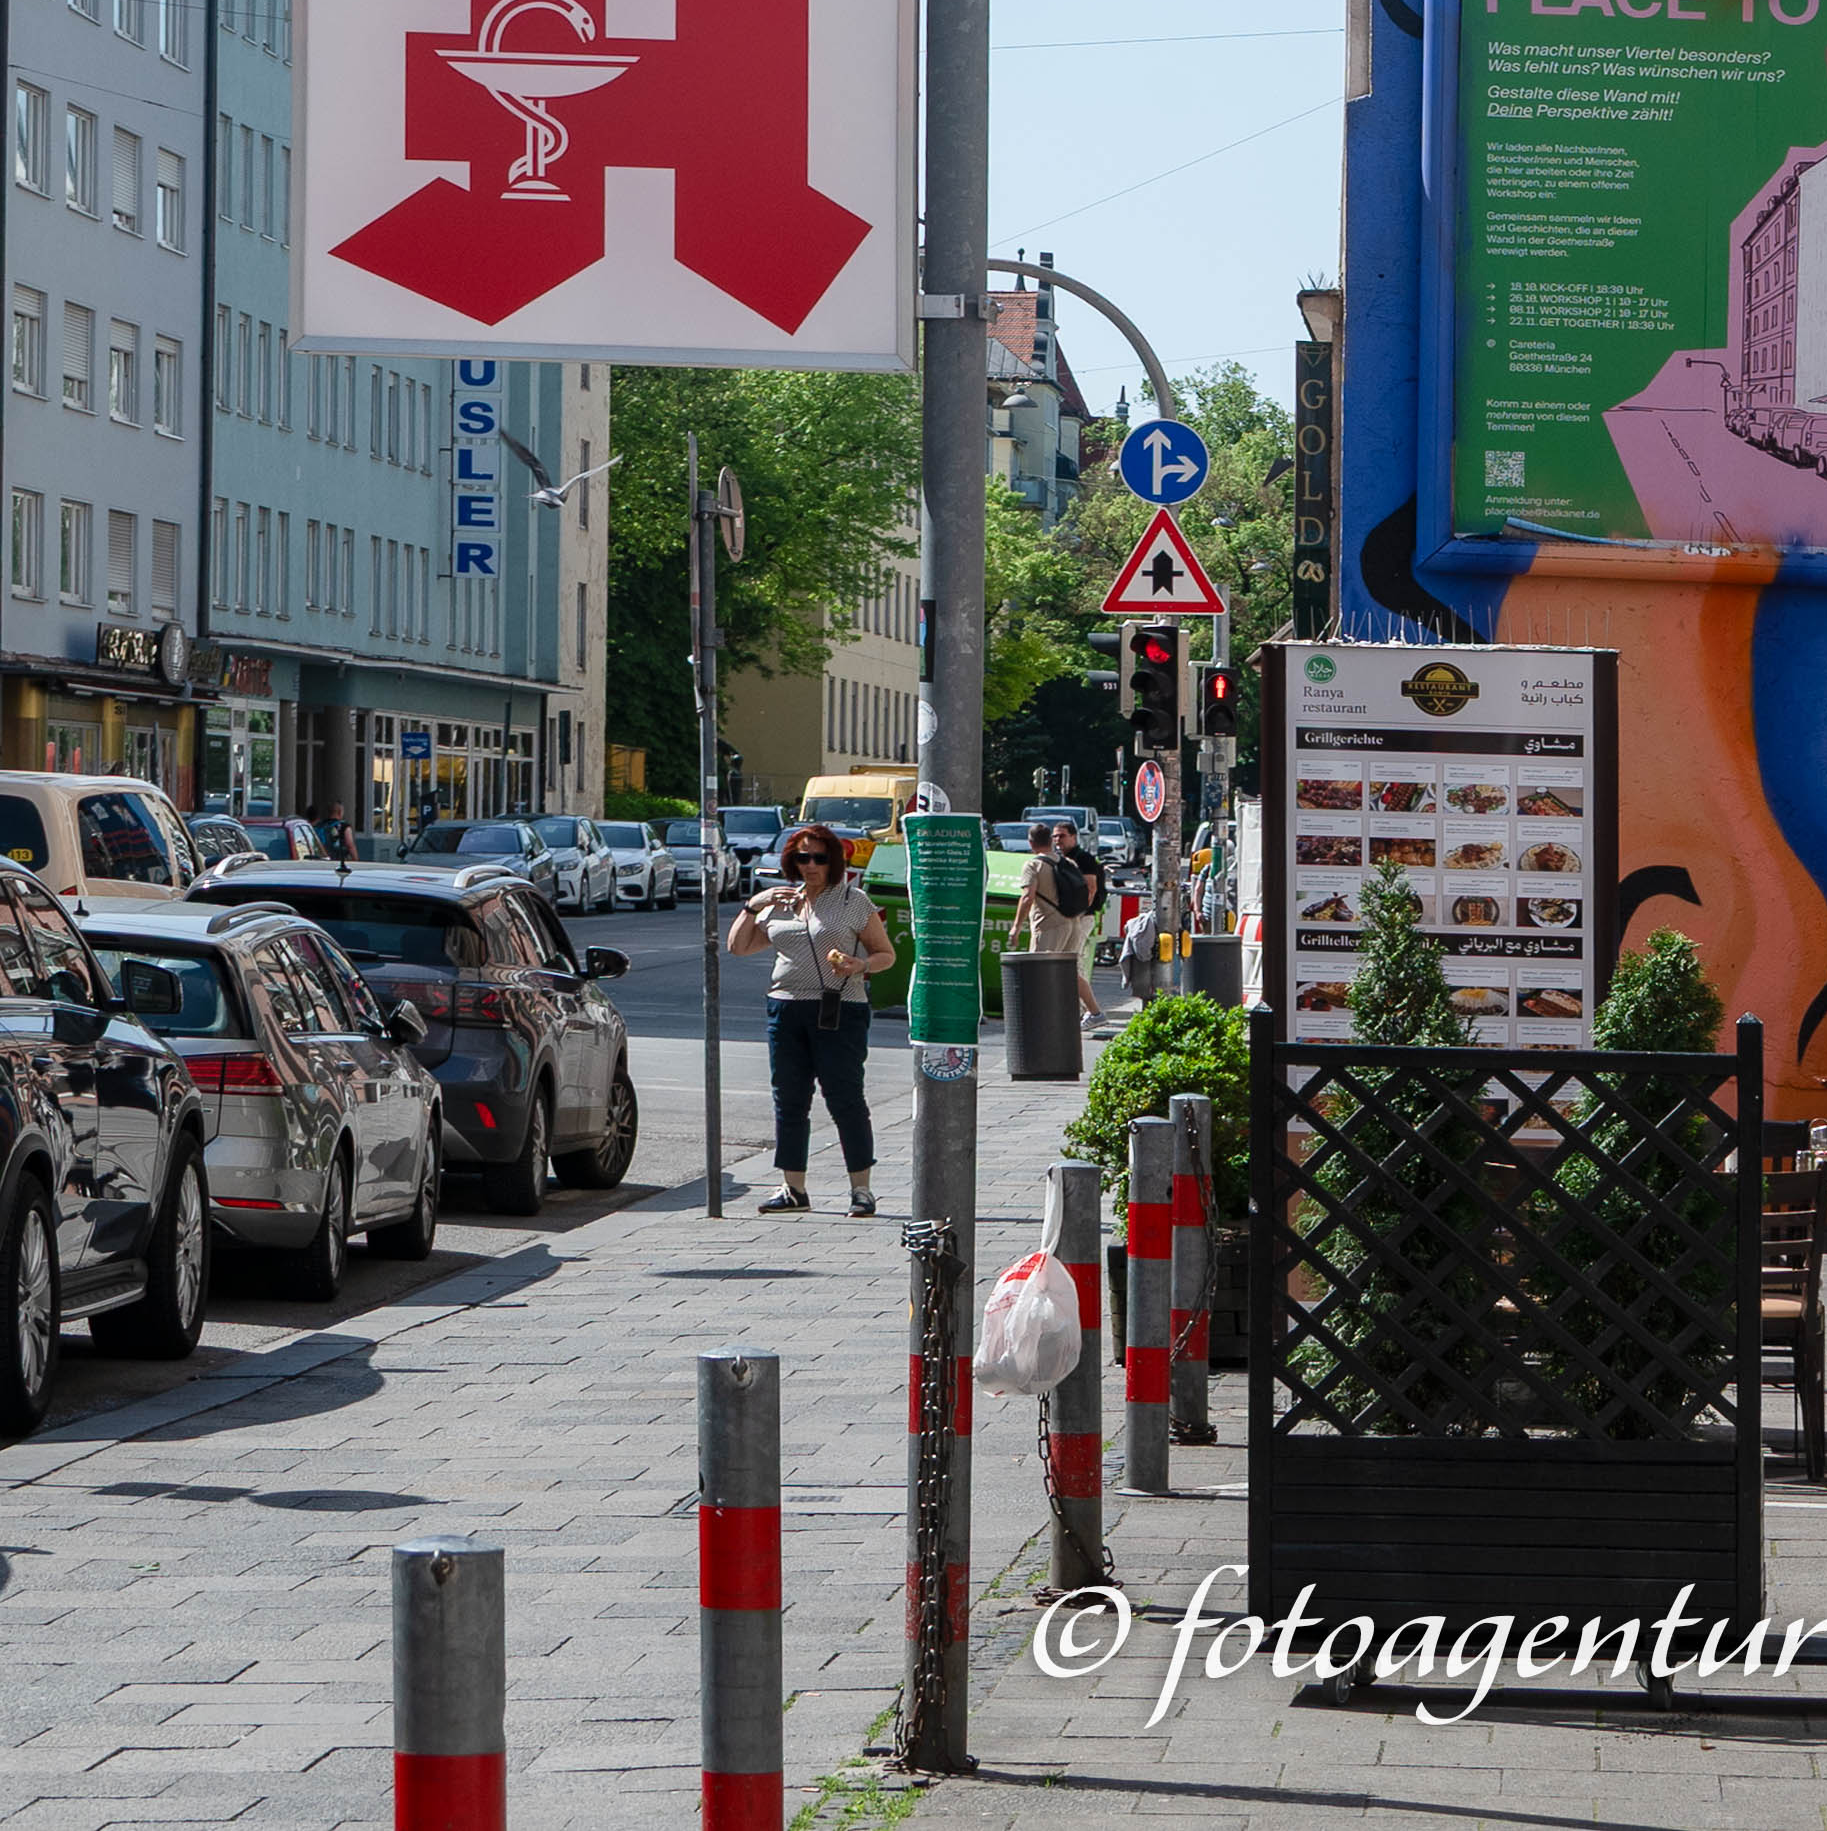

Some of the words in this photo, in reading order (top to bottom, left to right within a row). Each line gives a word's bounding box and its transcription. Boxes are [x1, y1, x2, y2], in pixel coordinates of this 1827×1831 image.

[1489, 42, 1521, 56] Was
[1524, 43, 1574, 58] macht
[1578, 46, 1621, 59] unser
[1626, 46, 1675, 61] Viertel
[1678, 48, 1771, 65] besonders?
[1488, 59, 1520, 73] Was
[1524, 60, 1558, 74] fehlt
[1562, 62, 1599, 75] uns?
[1602, 63, 1635, 76] Was
[1639, 64, 1717, 79] wünschen
[1721, 68, 1744, 80] wir
[1747, 69, 1785, 82] uns?
[1488, 85, 1553, 100] Gestalte
[1556, 87, 1599, 101] diese
[1603, 89, 1647, 103] Wand
[1651, 91, 1681, 104] mit!
[1487, 103, 1533, 118] Deine
[1537, 104, 1628, 120] Perspektive
[1632, 106, 1673, 121] zählt!
[1487, 142, 1503, 150] Wir
[1506, 143, 1533, 152] laden
[1535, 144, 1553, 153] alle
[1564, 156, 1583, 165] und
[1585, 158, 1640, 167] Menschen,
[1487, 165, 1502, 174] die
[1505, 166, 1523, 175] hier
[1526, 167, 1566, 176] arbeiten
[1568, 169, 1592, 177] oder
[1594, 169, 1612, 178] ihre
[1616, 170, 1634, 178] Zeit
[1487, 177, 1542, 188] verbringen,
[1558, 180, 1589, 188] einem
[1591, 180, 1629, 189] offenen
[1487, 189, 1536, 199] Workshop
[1539, 190, 1556, 199] ein:
[1487, 212, 1547, 221] Gemeinsam
[1549, 214, 1594, 223] sammeln
[1597, 215, 1611, 223] wir
[1614, 215, 1641, 224] Ideen
[1508, 224, 1573, 234] Geschichten,
[1576, 226, 1590, 234] die
[1608, 227, 1638, 236] dieser
[1487, 235, 1514, 244] Wand
[1517, 236, 1526, 244] in
[1528, 236, 1544, 245] der
[1547, 237, 1614, 247] Goethestraße
[1486, 246, 1528, 257] verewigt
[1531, 248, 1569, 257] werden.
[1509, 339, 1555, 350] Careteria
[1509, 351, 1577, 362] Goethestraße
[1580, 354, 1592, 362] 24
[1509, 363, 1542, 373] 80336
[1545, 364, 1591, 374] München
[1486, 399, 1519, 409] Komm
[1535, 401, 1565, 410] einem
[1568, 402, 1590, 411] oder
[1487, 411, 1534, 420] mehreren
[1556, 413, 1589, 422] diesen
[1487, 422, 1535, 432] Terminen!
[1299, 380, 1327, 546] GOLD
[1485, 495, 1542, 506] Anmeldung
[1544, 497, 1572, 506] unter:
[1532, 679, 1584, 690] مطعم
[1303, 686, 1344, 700] Ranya
[1551, 693, 1584, 705] كباب
[1303, 703, 1367, 714] restaurant
[1305, 731, 1383, 746] Grillgerichte
[423, 805, 432, 815] P
